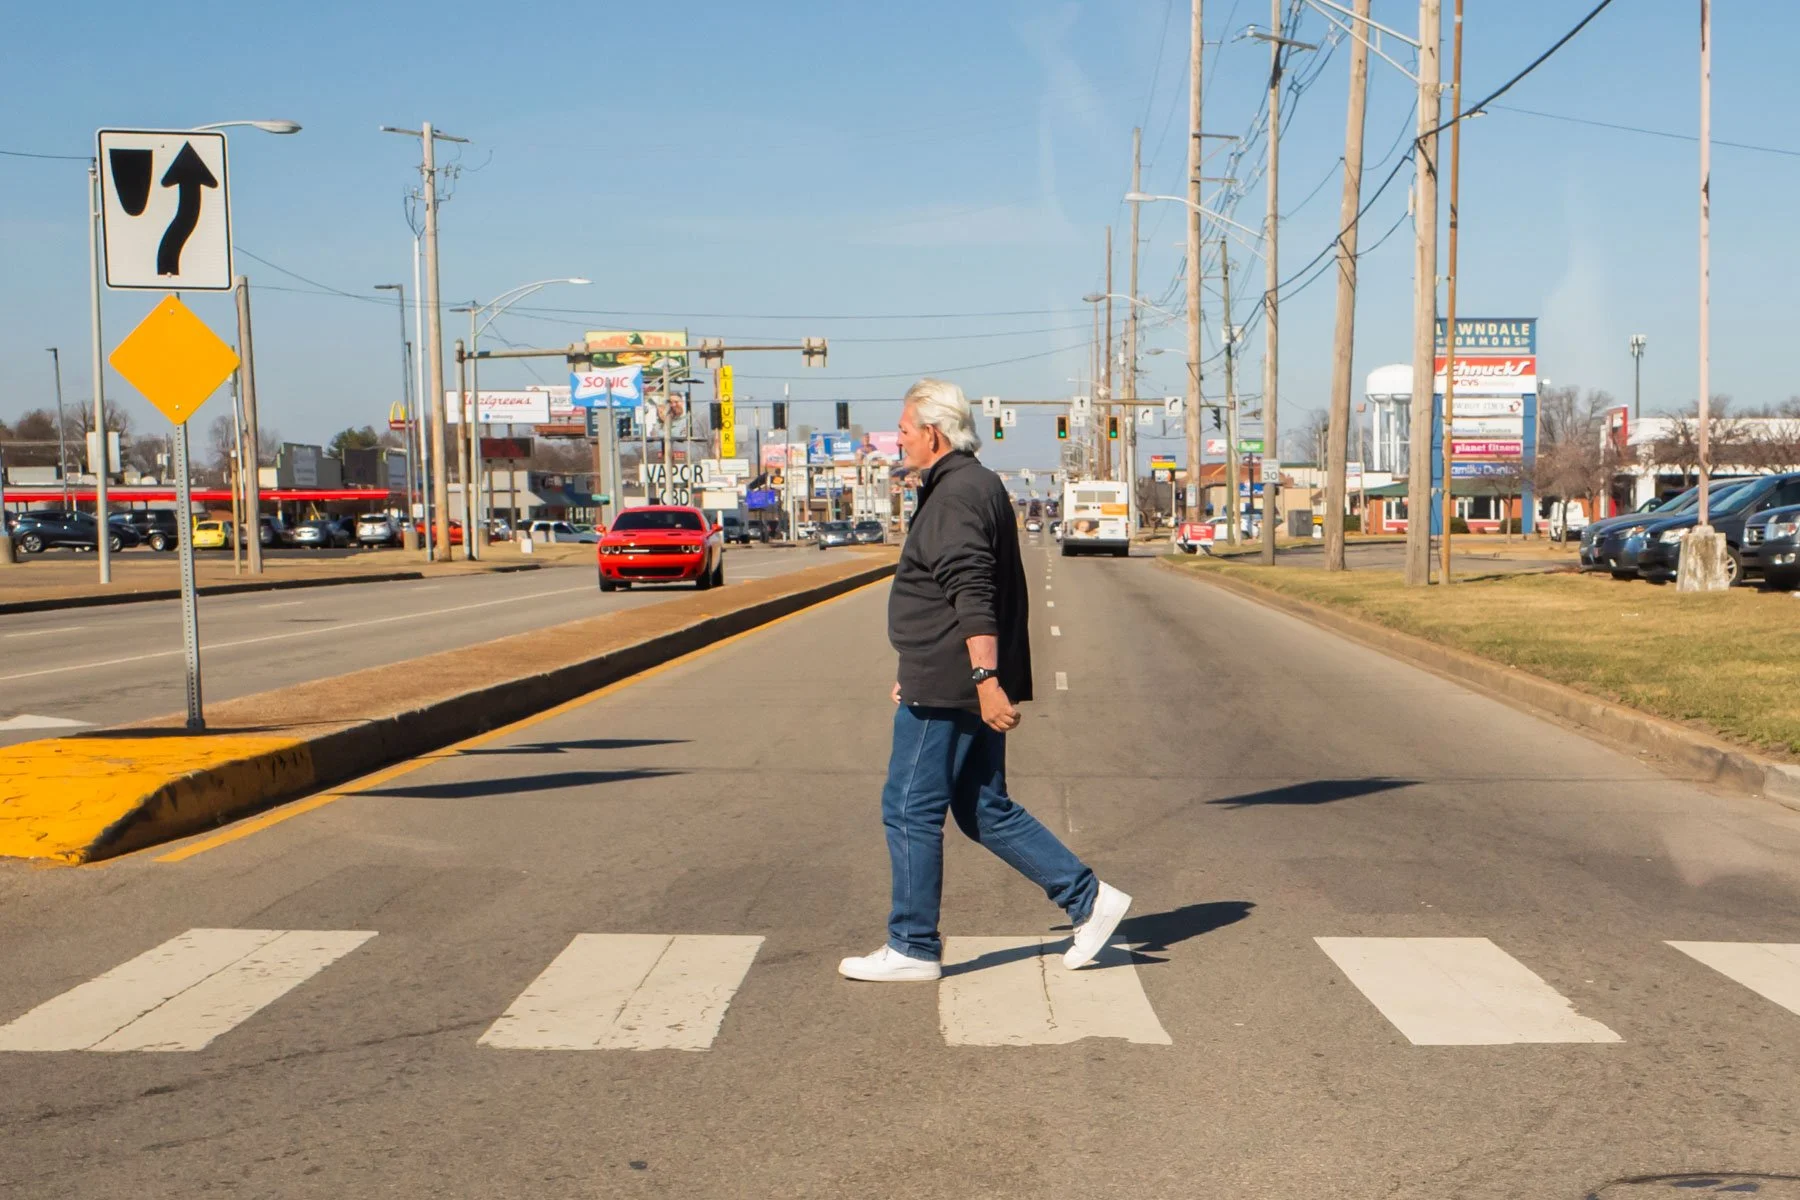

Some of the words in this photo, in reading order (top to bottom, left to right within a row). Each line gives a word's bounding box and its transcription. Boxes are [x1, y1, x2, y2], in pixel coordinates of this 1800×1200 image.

[1436, 323, 1530, 336] LWNDALE
[1448, 337, 1521, 346] OMMONS
[583, 376, 629, 388] SONIC
[722, 367, 732, 442] LIQUOR
[1455, 443, 1485, 454] planet
[1487, 443, 1520, 452] fitness
[647, 465, 703, 483] VAPOR
[1263, 472, 1278, 481] 30
[661, 489, 689, 506] CBD
